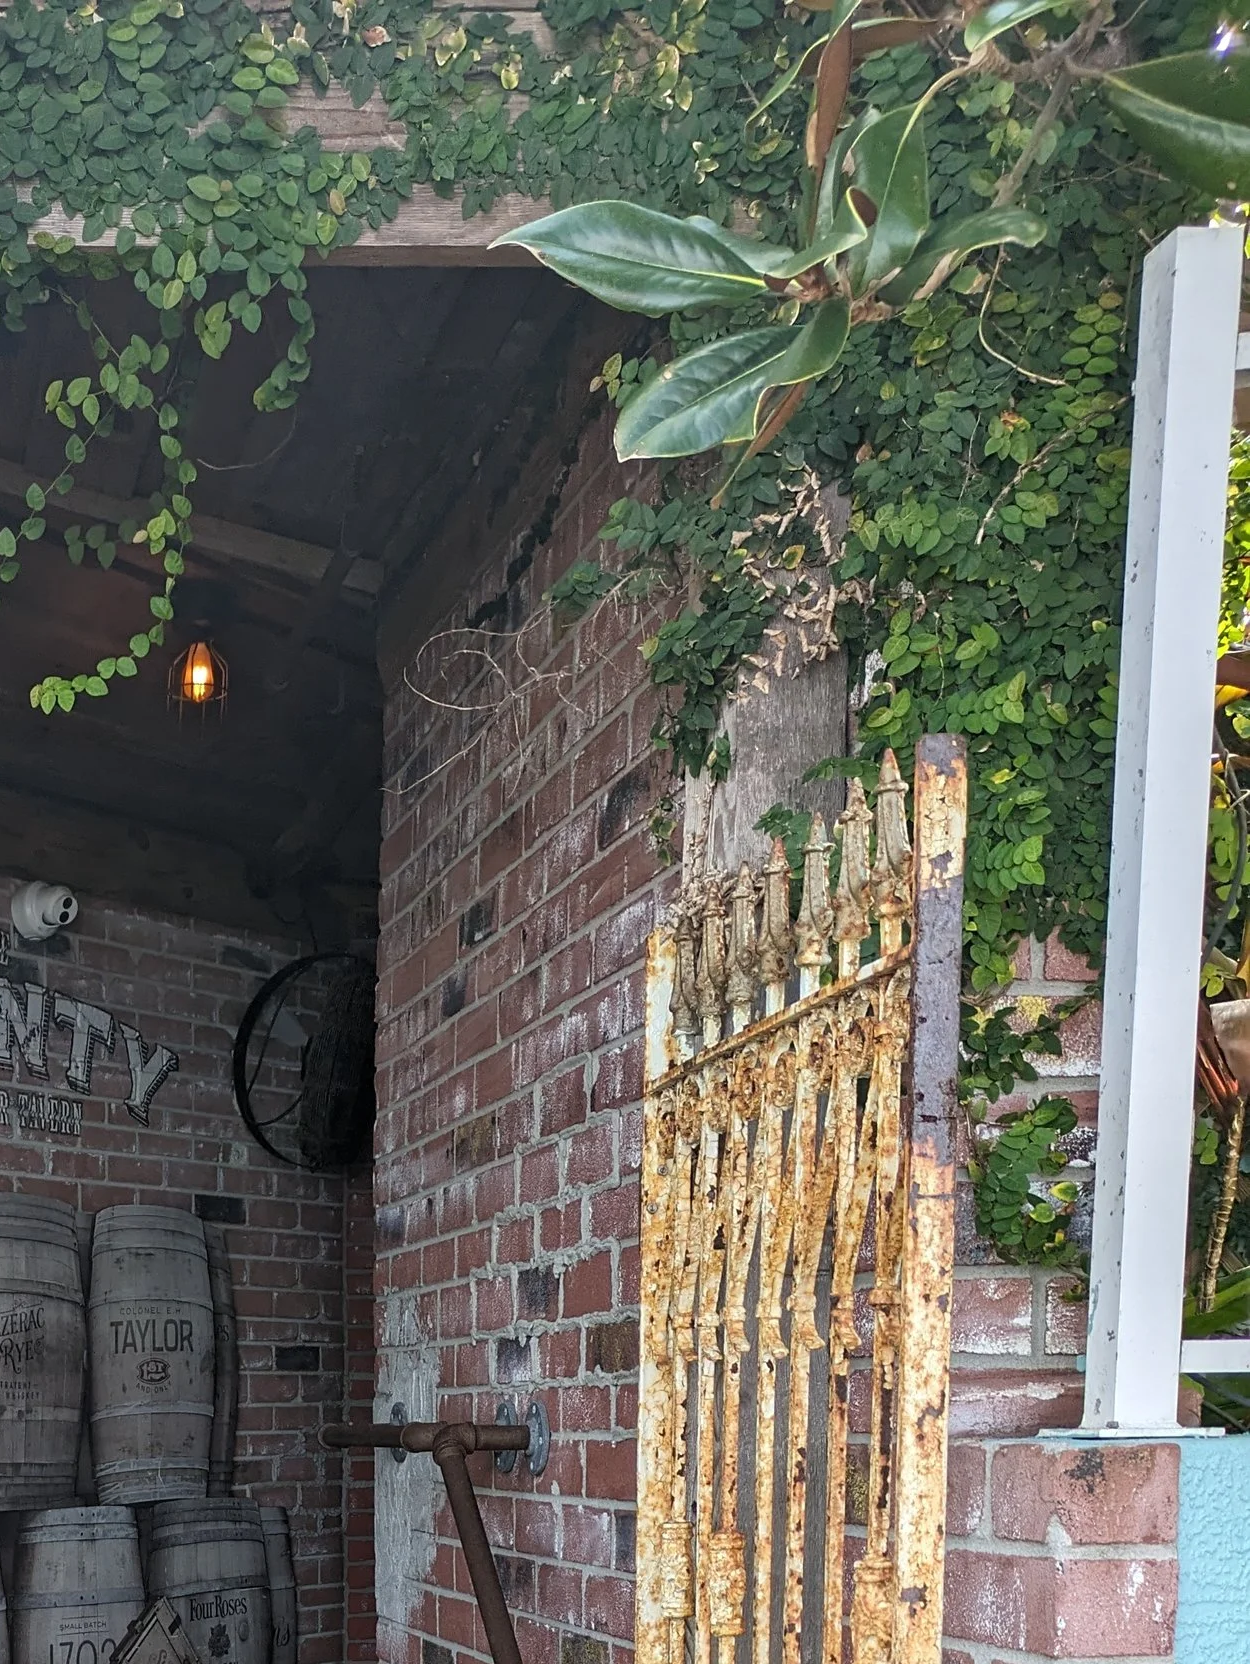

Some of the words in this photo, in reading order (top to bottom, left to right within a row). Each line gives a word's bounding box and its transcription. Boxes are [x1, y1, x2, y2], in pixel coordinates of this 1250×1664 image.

[17, 1091, 83, 1137] TAVERN
[119, 1306, 161, 1317] COLONEL
[109, 1318, 195, 1355] TAYLOR
[0, 1337, 35, 1374] RYE
[59, 1622, 83, 1632] SMALL
[83, 1620, 107, 1631] BATCH
